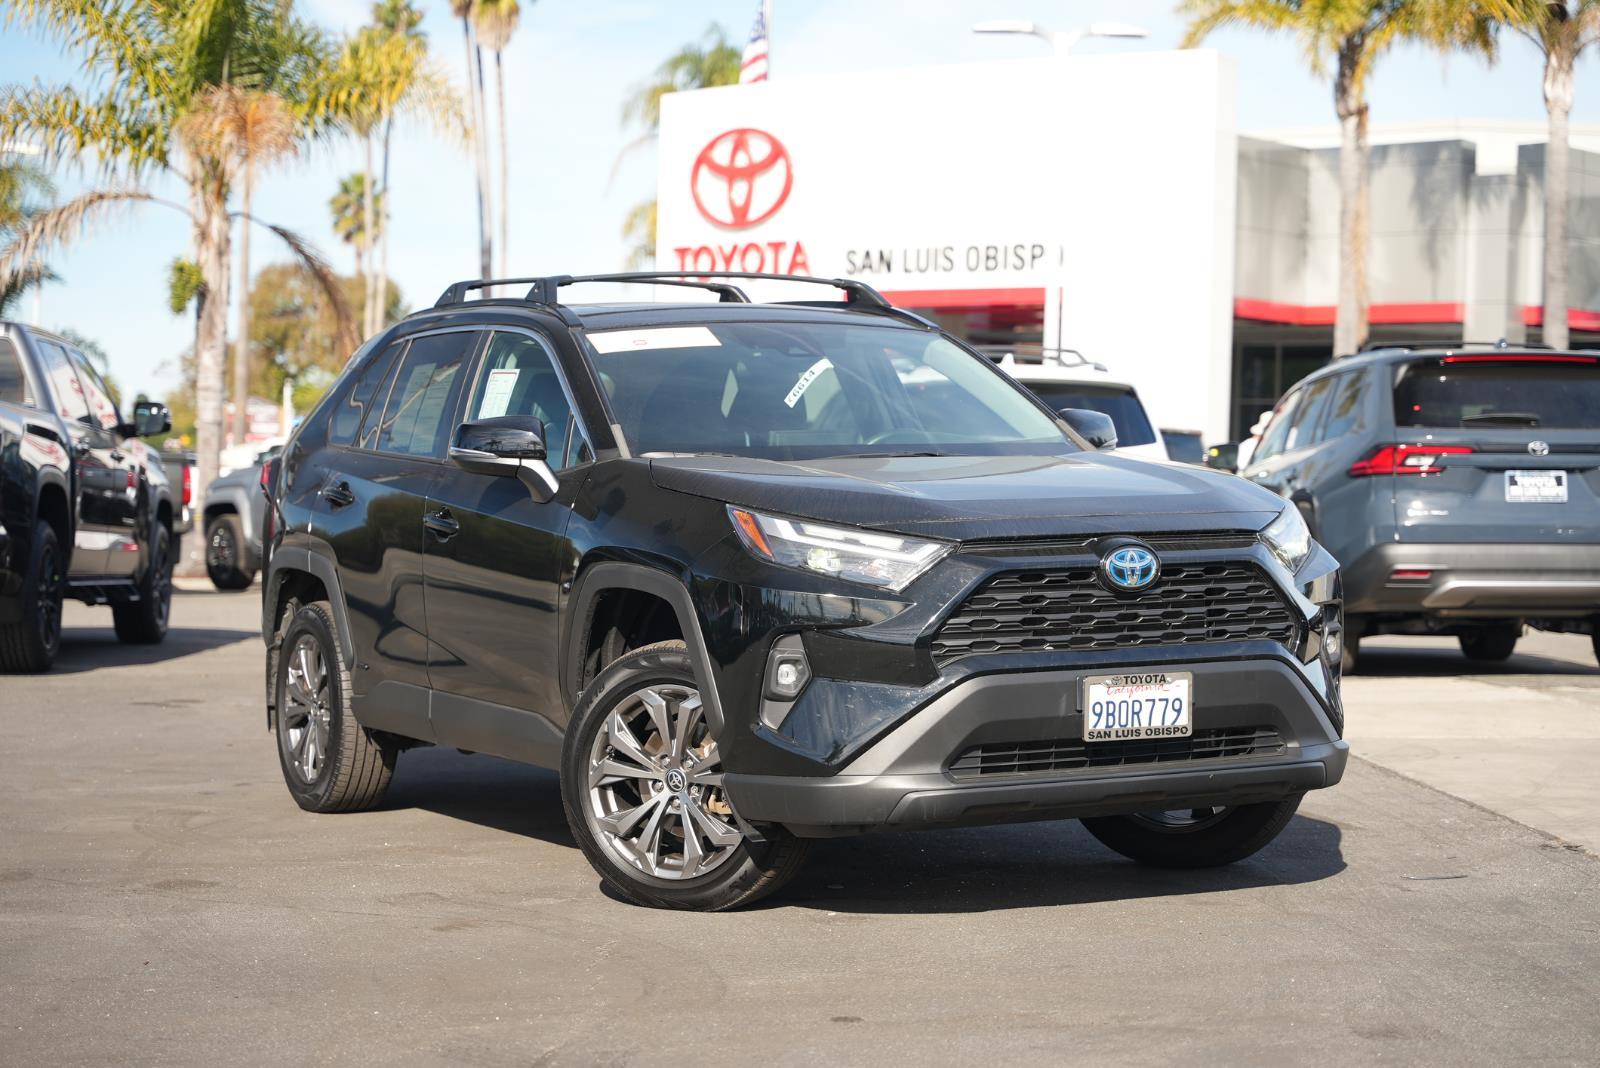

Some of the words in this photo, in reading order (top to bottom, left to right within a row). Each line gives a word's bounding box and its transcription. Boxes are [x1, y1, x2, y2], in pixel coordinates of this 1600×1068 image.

[674, 241, 811, 281] TOYOTA
[846, 249, 893, 275] SAN
[904, 246, 954, 273] LUIS
[966, 244, 1063, 271] OBISP
[1124, 675, 1166, 684] TOYOTA
[1088, 730, 1111, 740] SAN
[1115, 728, 1141, 738] LUIS
[1145, 726, 1189, 736] OBISPO
